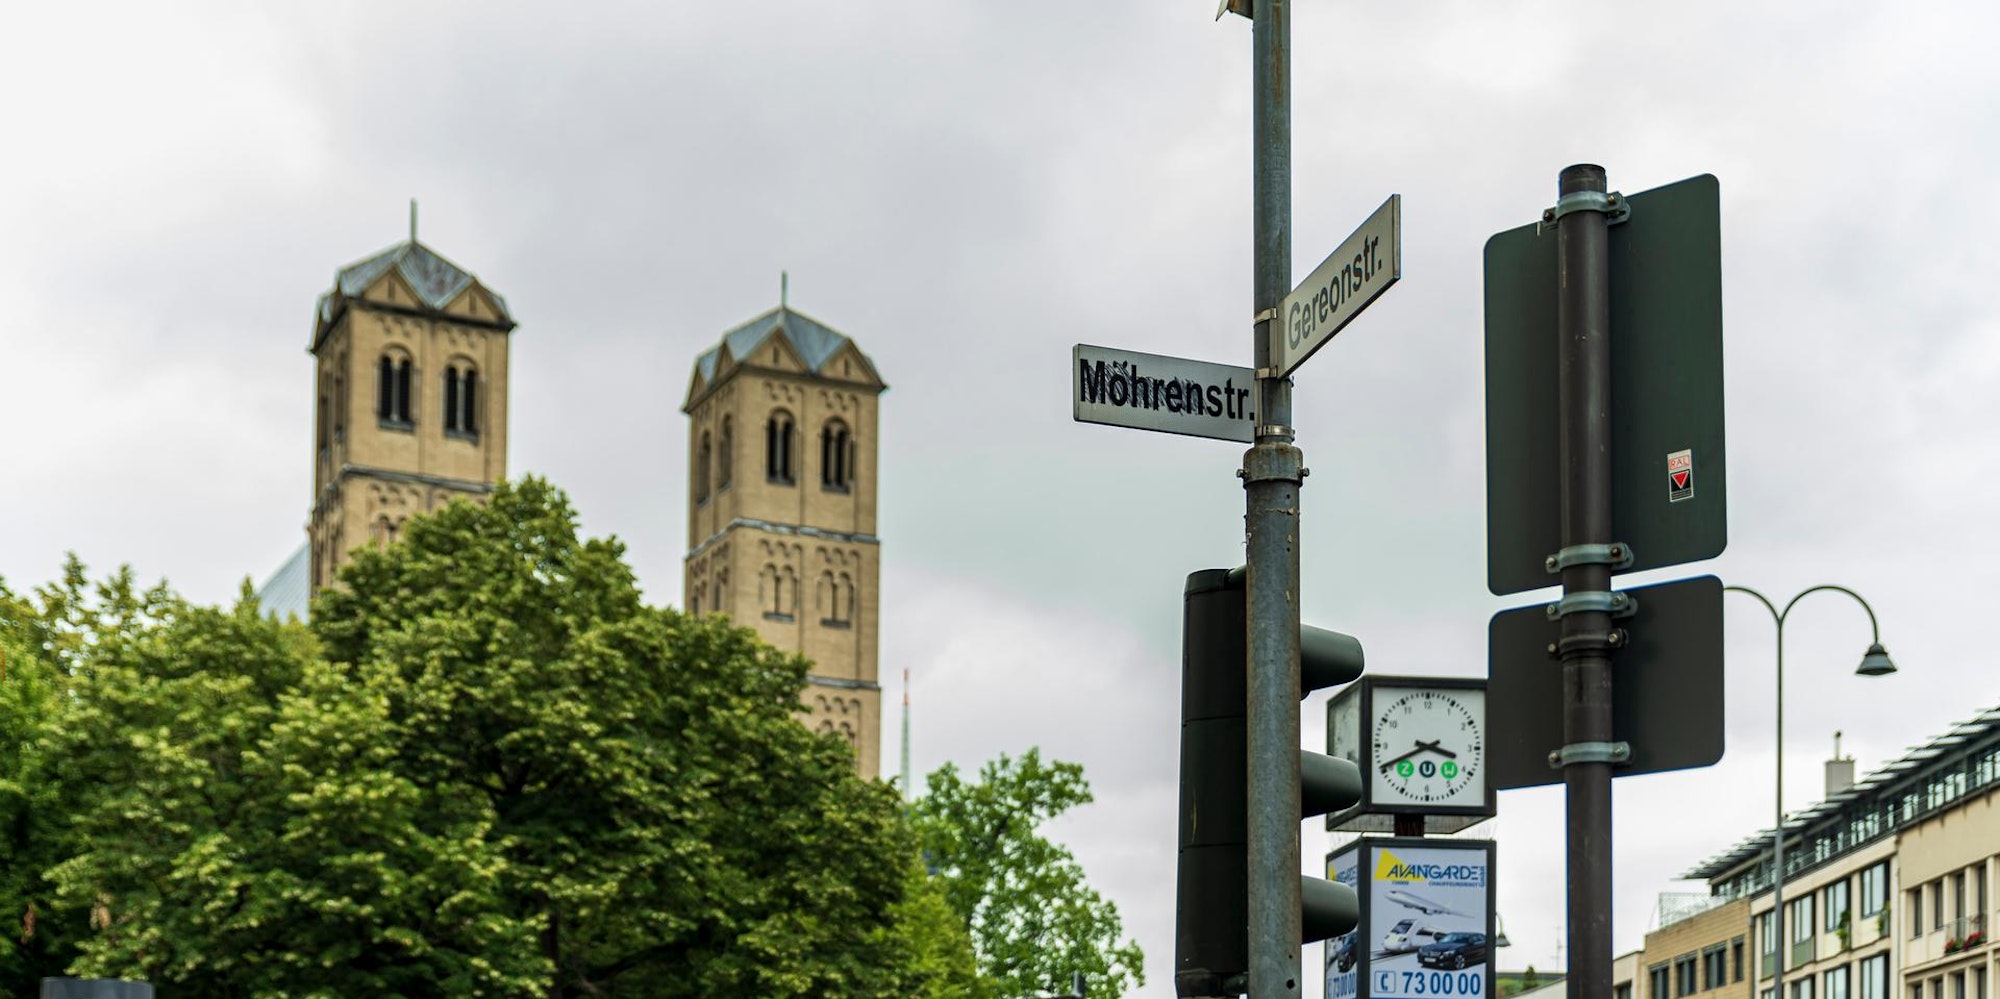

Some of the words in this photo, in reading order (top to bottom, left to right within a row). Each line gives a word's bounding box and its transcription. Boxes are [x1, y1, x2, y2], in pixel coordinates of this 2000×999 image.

[1288, 235, 1382, 350] Gereonstr.
[1079, 358, 1255, 421] Möhrenstr.
[1424, 701, 1432, 710] 12
[1404, 706, 1412, 715] 11
[1389, 720, 1397, 729] 10
[1461, 723, 1466, 731] 2
[1383, 742, 1388, 750] 9
[1467, 744, 1472, 752] 3
[1400, 763, 1409, 775] Z
[1422, 761, 1432, 775] U
[1444, 764, 1455, 775] W
[1424, 784, 1429, 793] 6
[1402, 972, 1425, 995] 73
[1430, 972, 1453, 995] 00
[1458, 973, 1480, 995] 00
